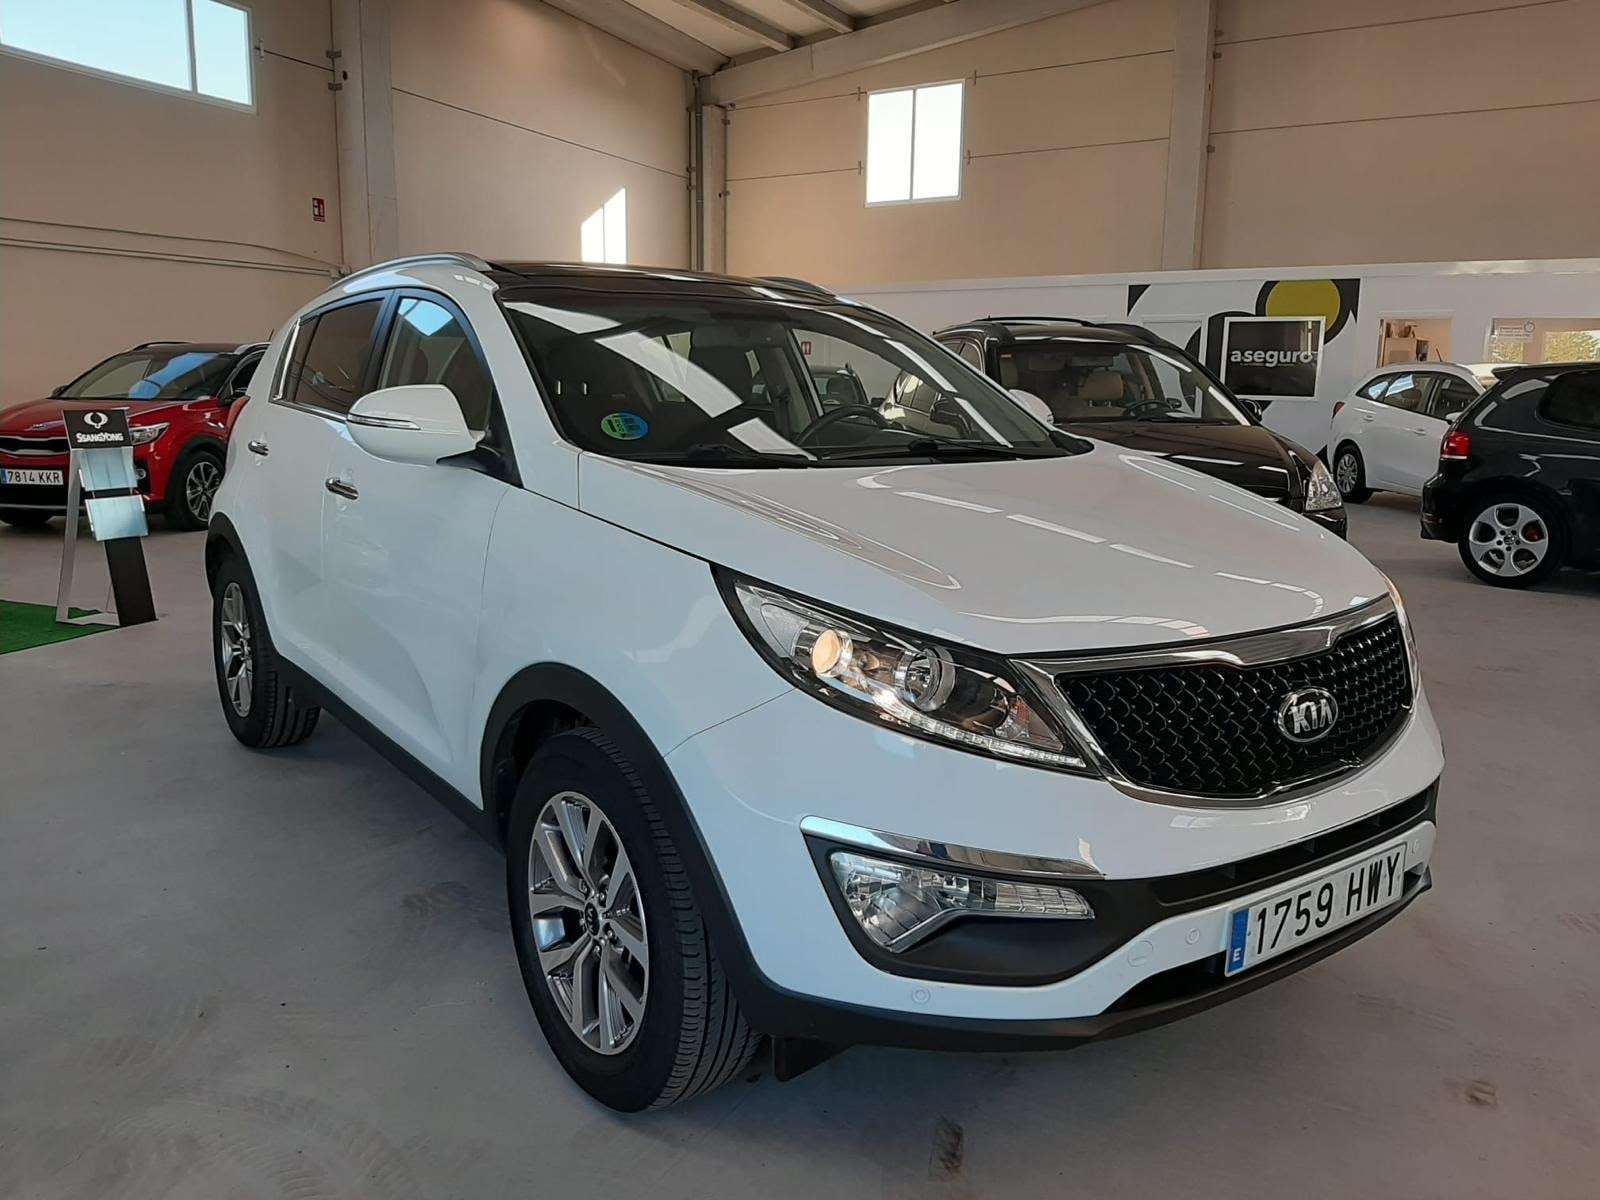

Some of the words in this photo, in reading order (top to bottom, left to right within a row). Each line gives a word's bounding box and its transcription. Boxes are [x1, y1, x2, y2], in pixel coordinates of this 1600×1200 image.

[8, 470, 35, 483] 7814
[38, 471, 61, 484] KKR
[1289, 699, 1333, 734] KIA
[1256, 883, 1334, 954] 1759
[1346, 852, 1400, 917] HWY
[1233, 949, 1241, 961] E
